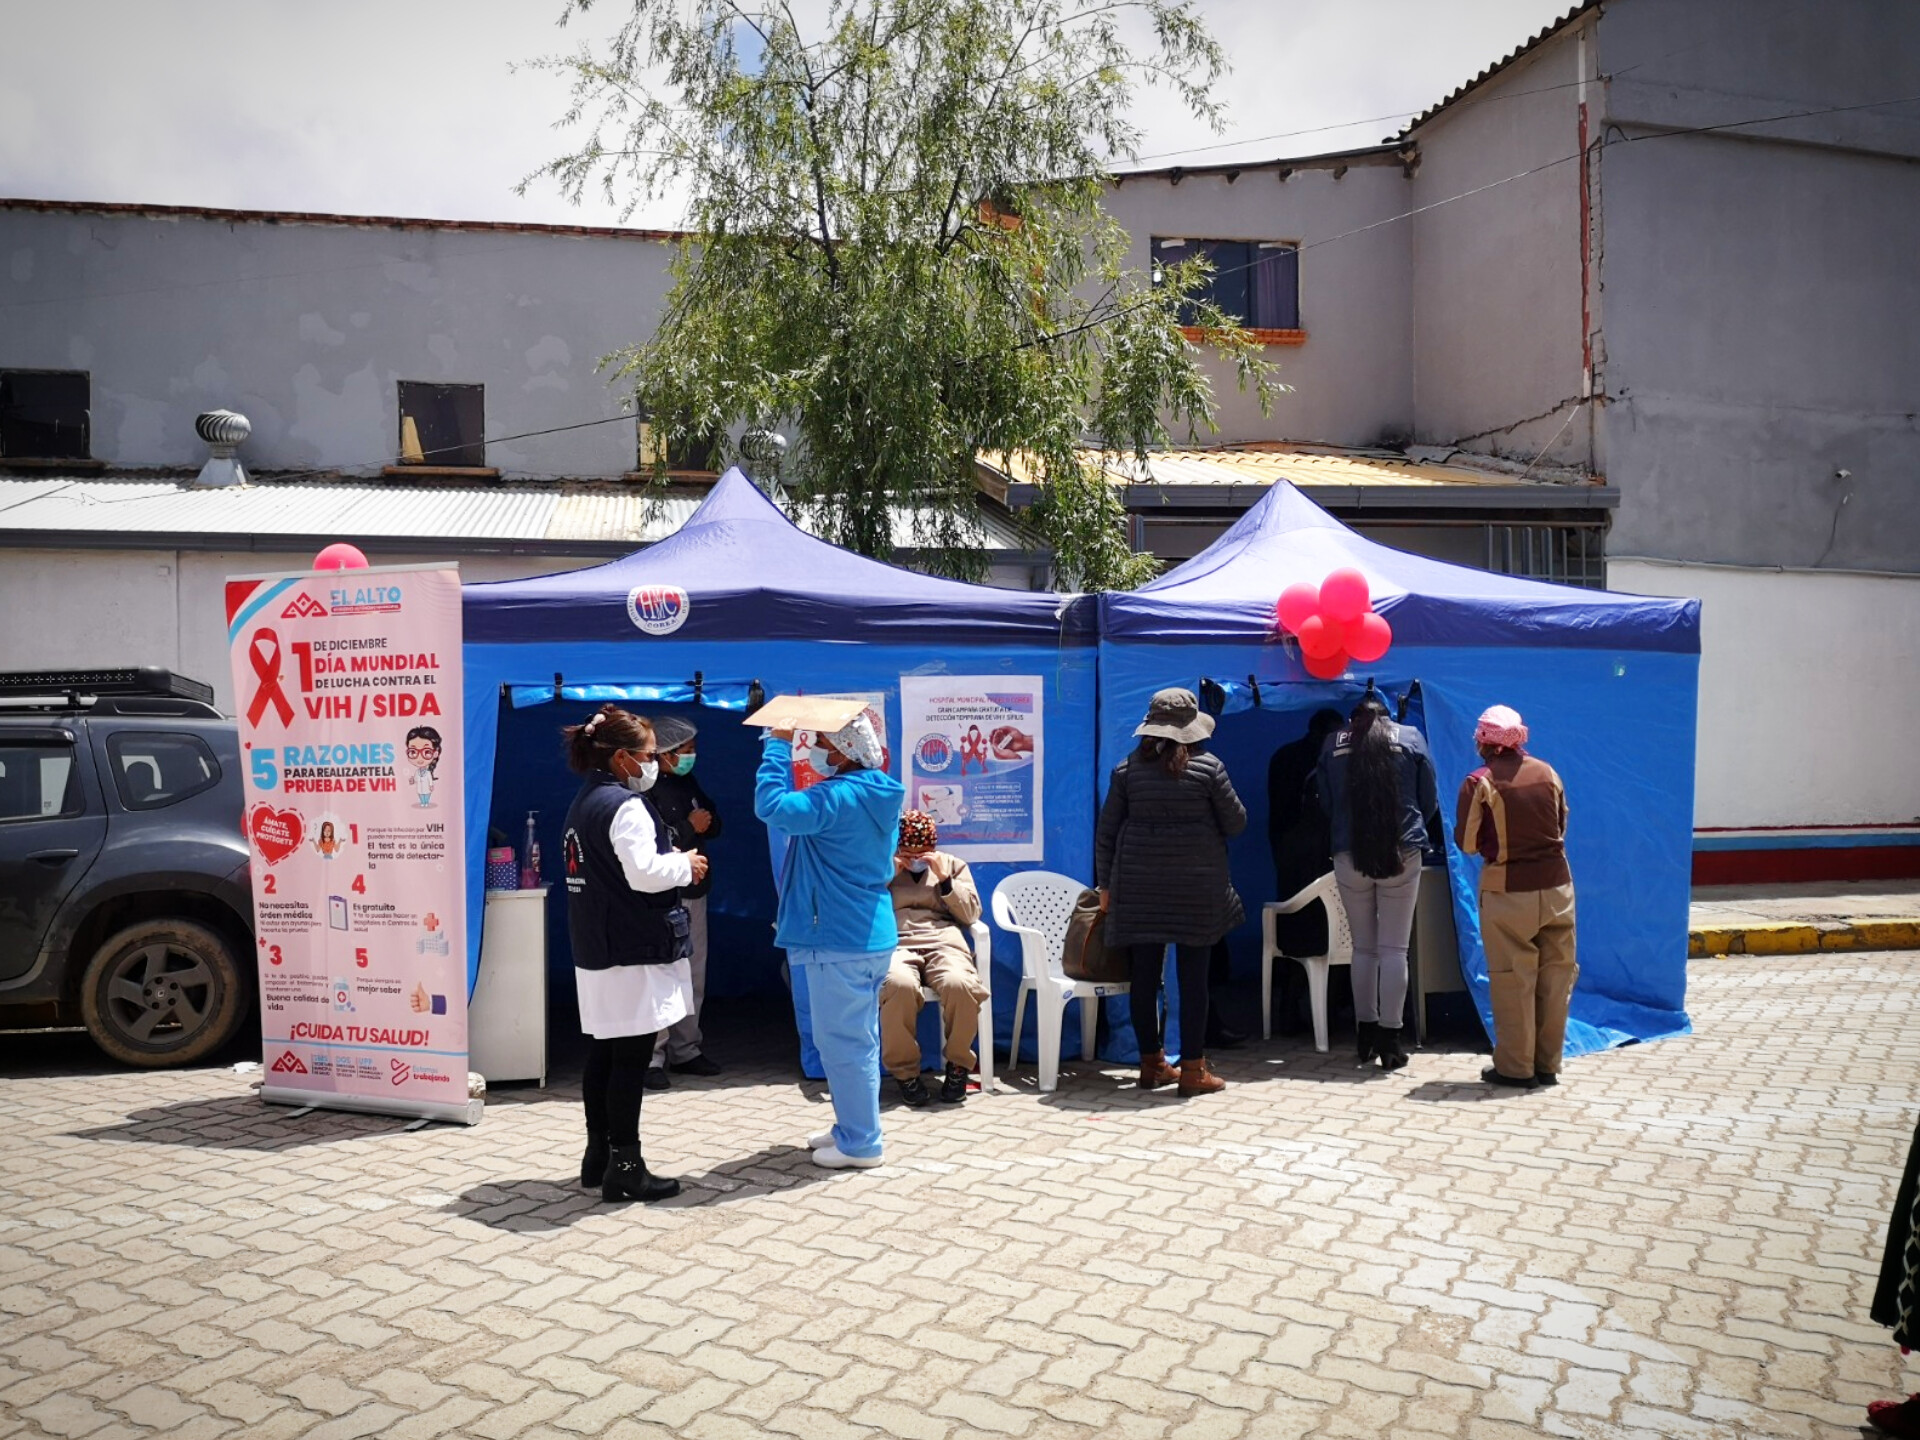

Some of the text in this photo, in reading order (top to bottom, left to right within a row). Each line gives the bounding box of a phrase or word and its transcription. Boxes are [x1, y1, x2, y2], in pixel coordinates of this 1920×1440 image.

[330, 586, 402, 605] EL ALTO
[646, 618, 677, 629] COREA
[314, 638, 387, 651] DE DICIEMBRE
[291, 642, 313, 692] 1
[315, 652, 440, 673] DÍA MUNDIAL
[315, 675, 436, 688] DE LUCHA CONTRA EL
[304, 692, 441, 723] VIH / SIDA
[284, 743, 395, 766] RAZONES
[250, 748, 278, 790] 5
[284, 766, 395, 778] PARA REALIZARTE LA
[284, 778, 396, 794] PRUEBA DE VIH
[349, 824, 358, 844] 1
[426, 823, 444, 832] VIH
[367, 842, 375, 850] El
[421, 841, 445, 850] única
[264, 874, 276, 894] 2
[352, 874, 366, 894] 4
[270, 901, 309, 909] necesitas
[362, 903, 395, 913] gratuito
[284, 910, 313, 919] médica
[269, 945, 282, 965] 3
[355, 948, 368, 968] 5
[357, 985, 402, 995] mejor saber
[293, 994, 319, 1003] calidad
[267, 1002, 284, 1010] vida
[290, 1022, 429, 1046] ¡CUIDA TU SALUD!
[413, 1073, 449, 1083] trabajando
